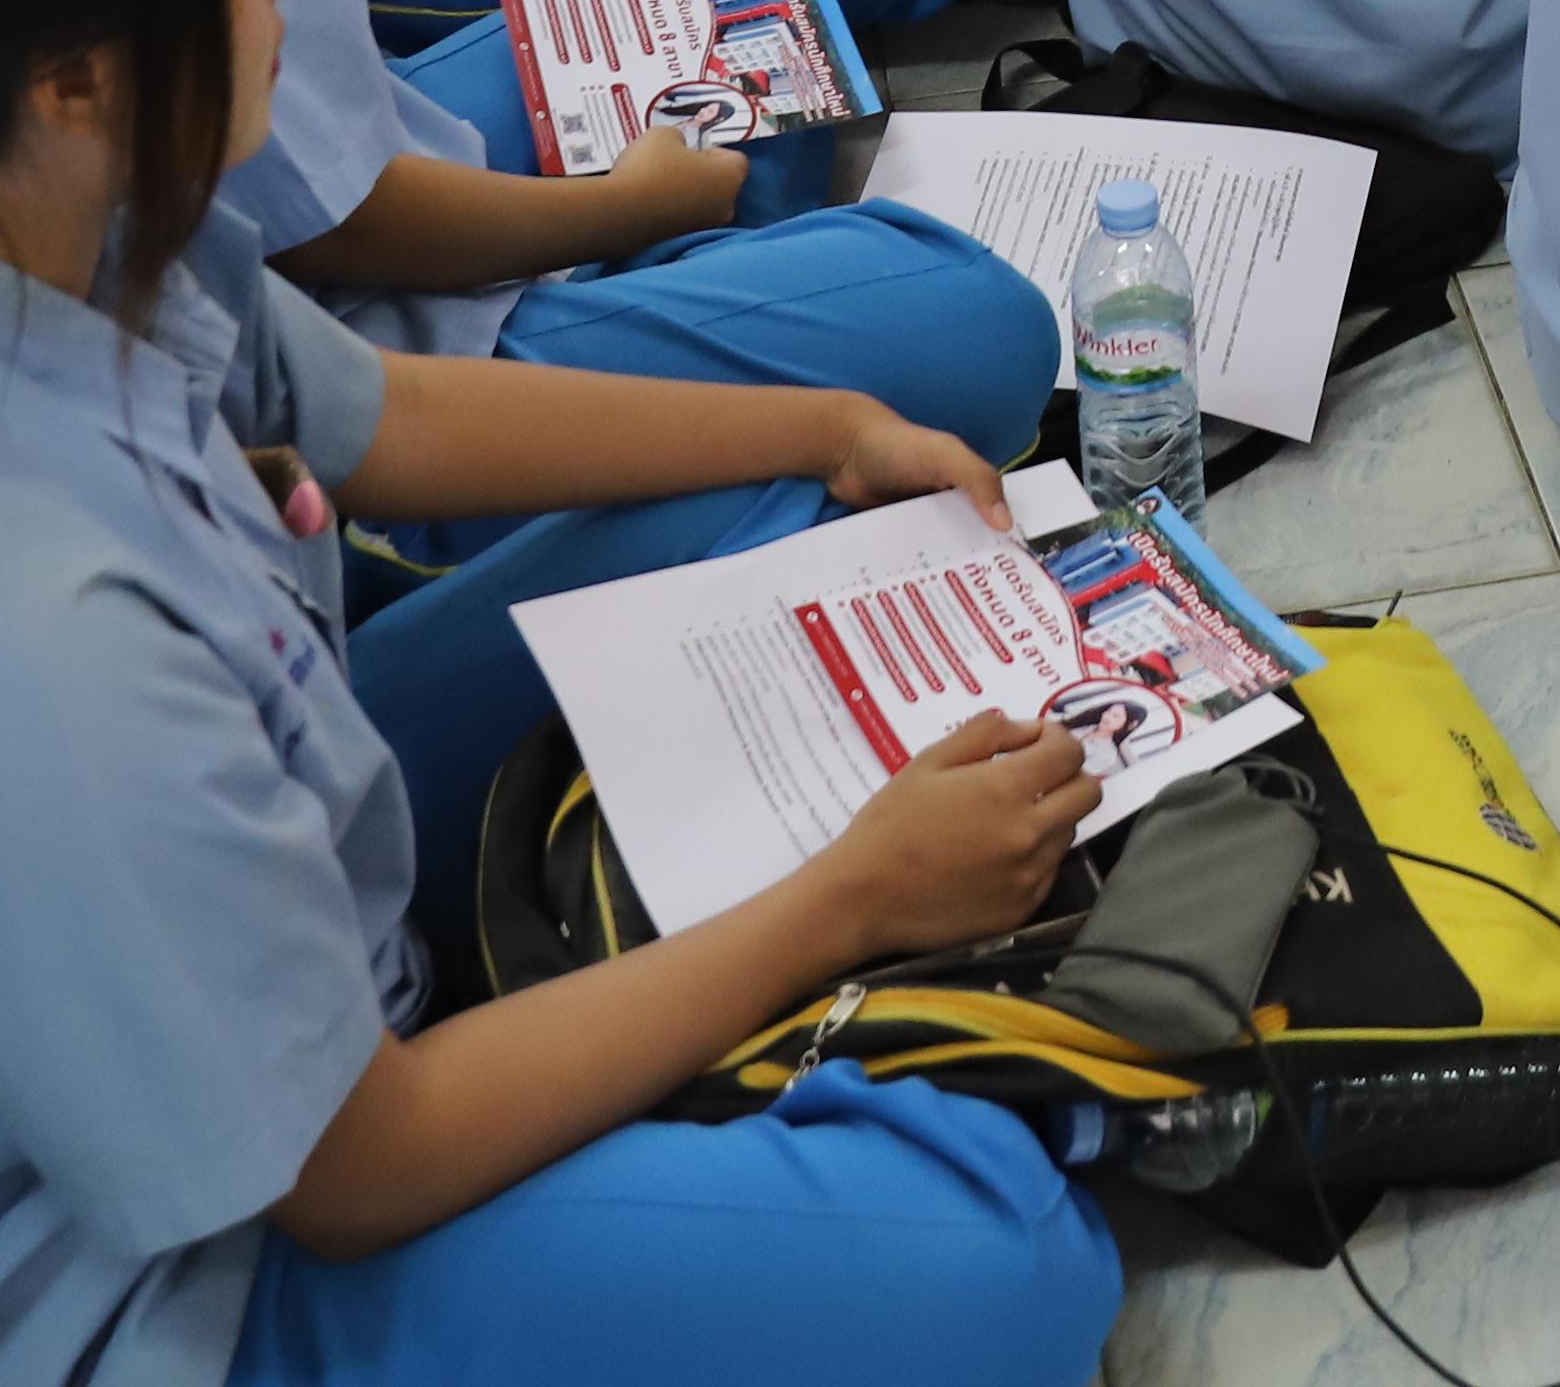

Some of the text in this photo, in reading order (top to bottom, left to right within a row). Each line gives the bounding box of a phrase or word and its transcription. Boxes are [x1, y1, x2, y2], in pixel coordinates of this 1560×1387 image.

[656, 31, 677, 41] 8
[659, 44, 687, 80] สาขา
[959, 557, 1066, 690] ทั้งหมด 8 สาขา
[987, 549, 1075, 649] เปิดรับสมัคร
